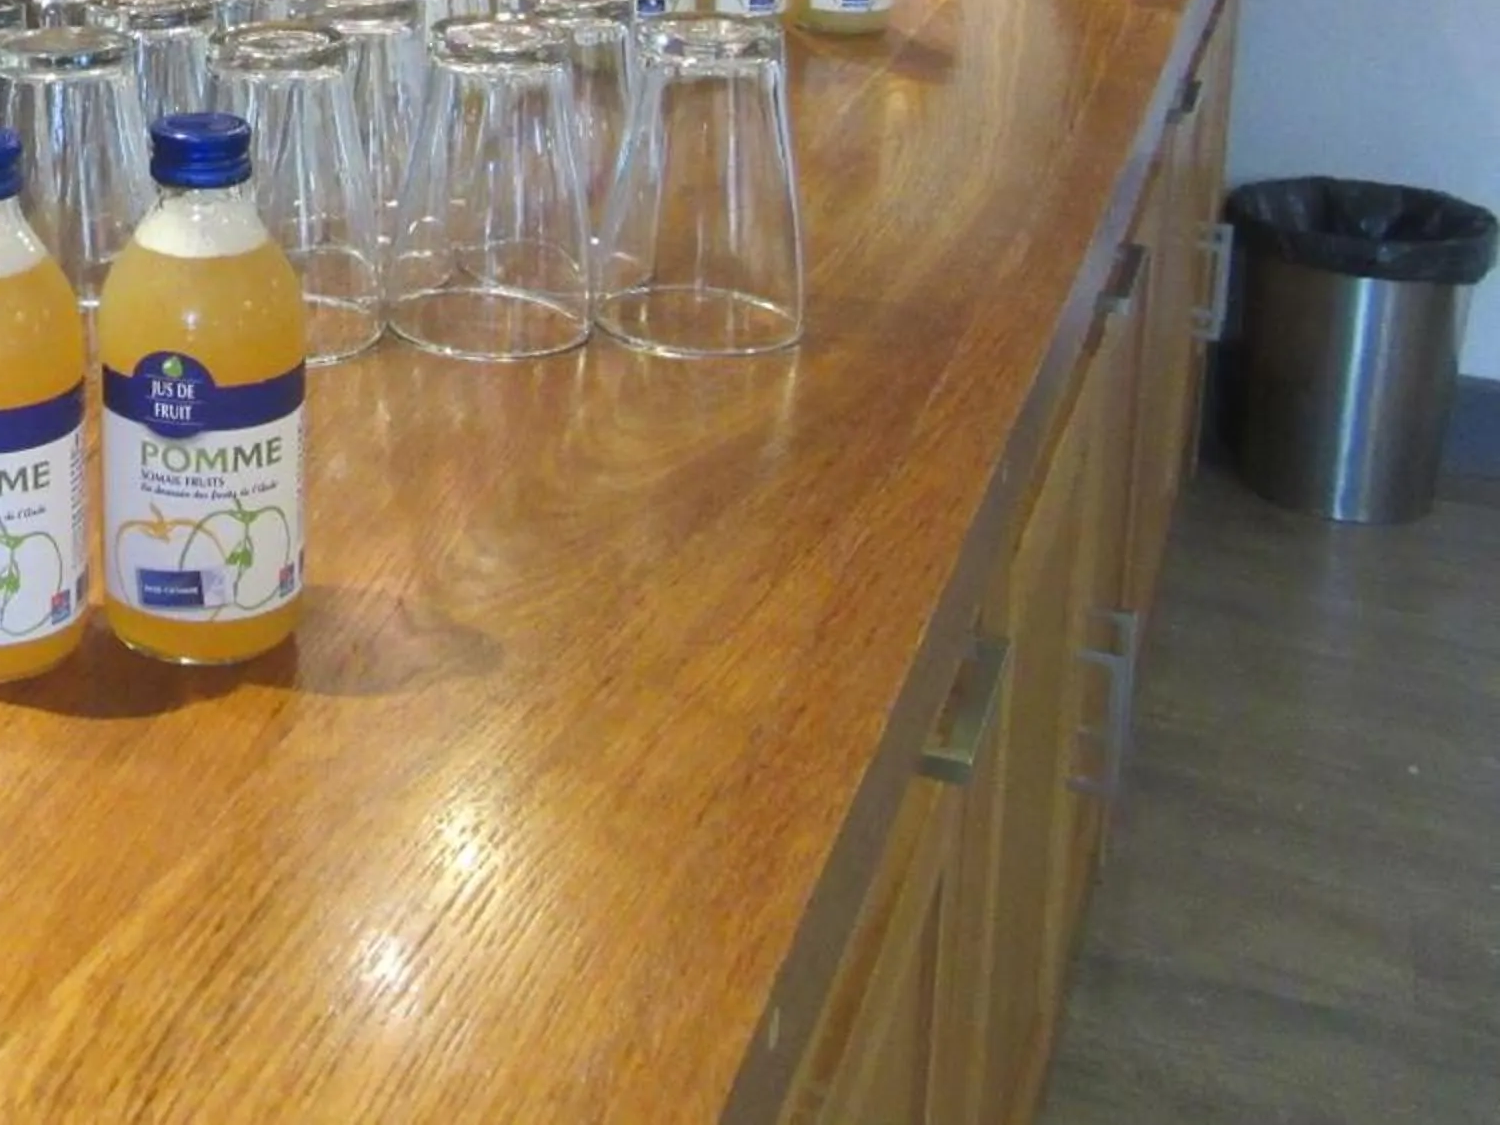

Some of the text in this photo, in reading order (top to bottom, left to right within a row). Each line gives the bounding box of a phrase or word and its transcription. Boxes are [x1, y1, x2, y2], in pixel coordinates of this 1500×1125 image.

[150, 380, 196, 400] JUS DE
[153, 402, 192, 421] FRUIT
[139, 436, 283, 473] POMME
